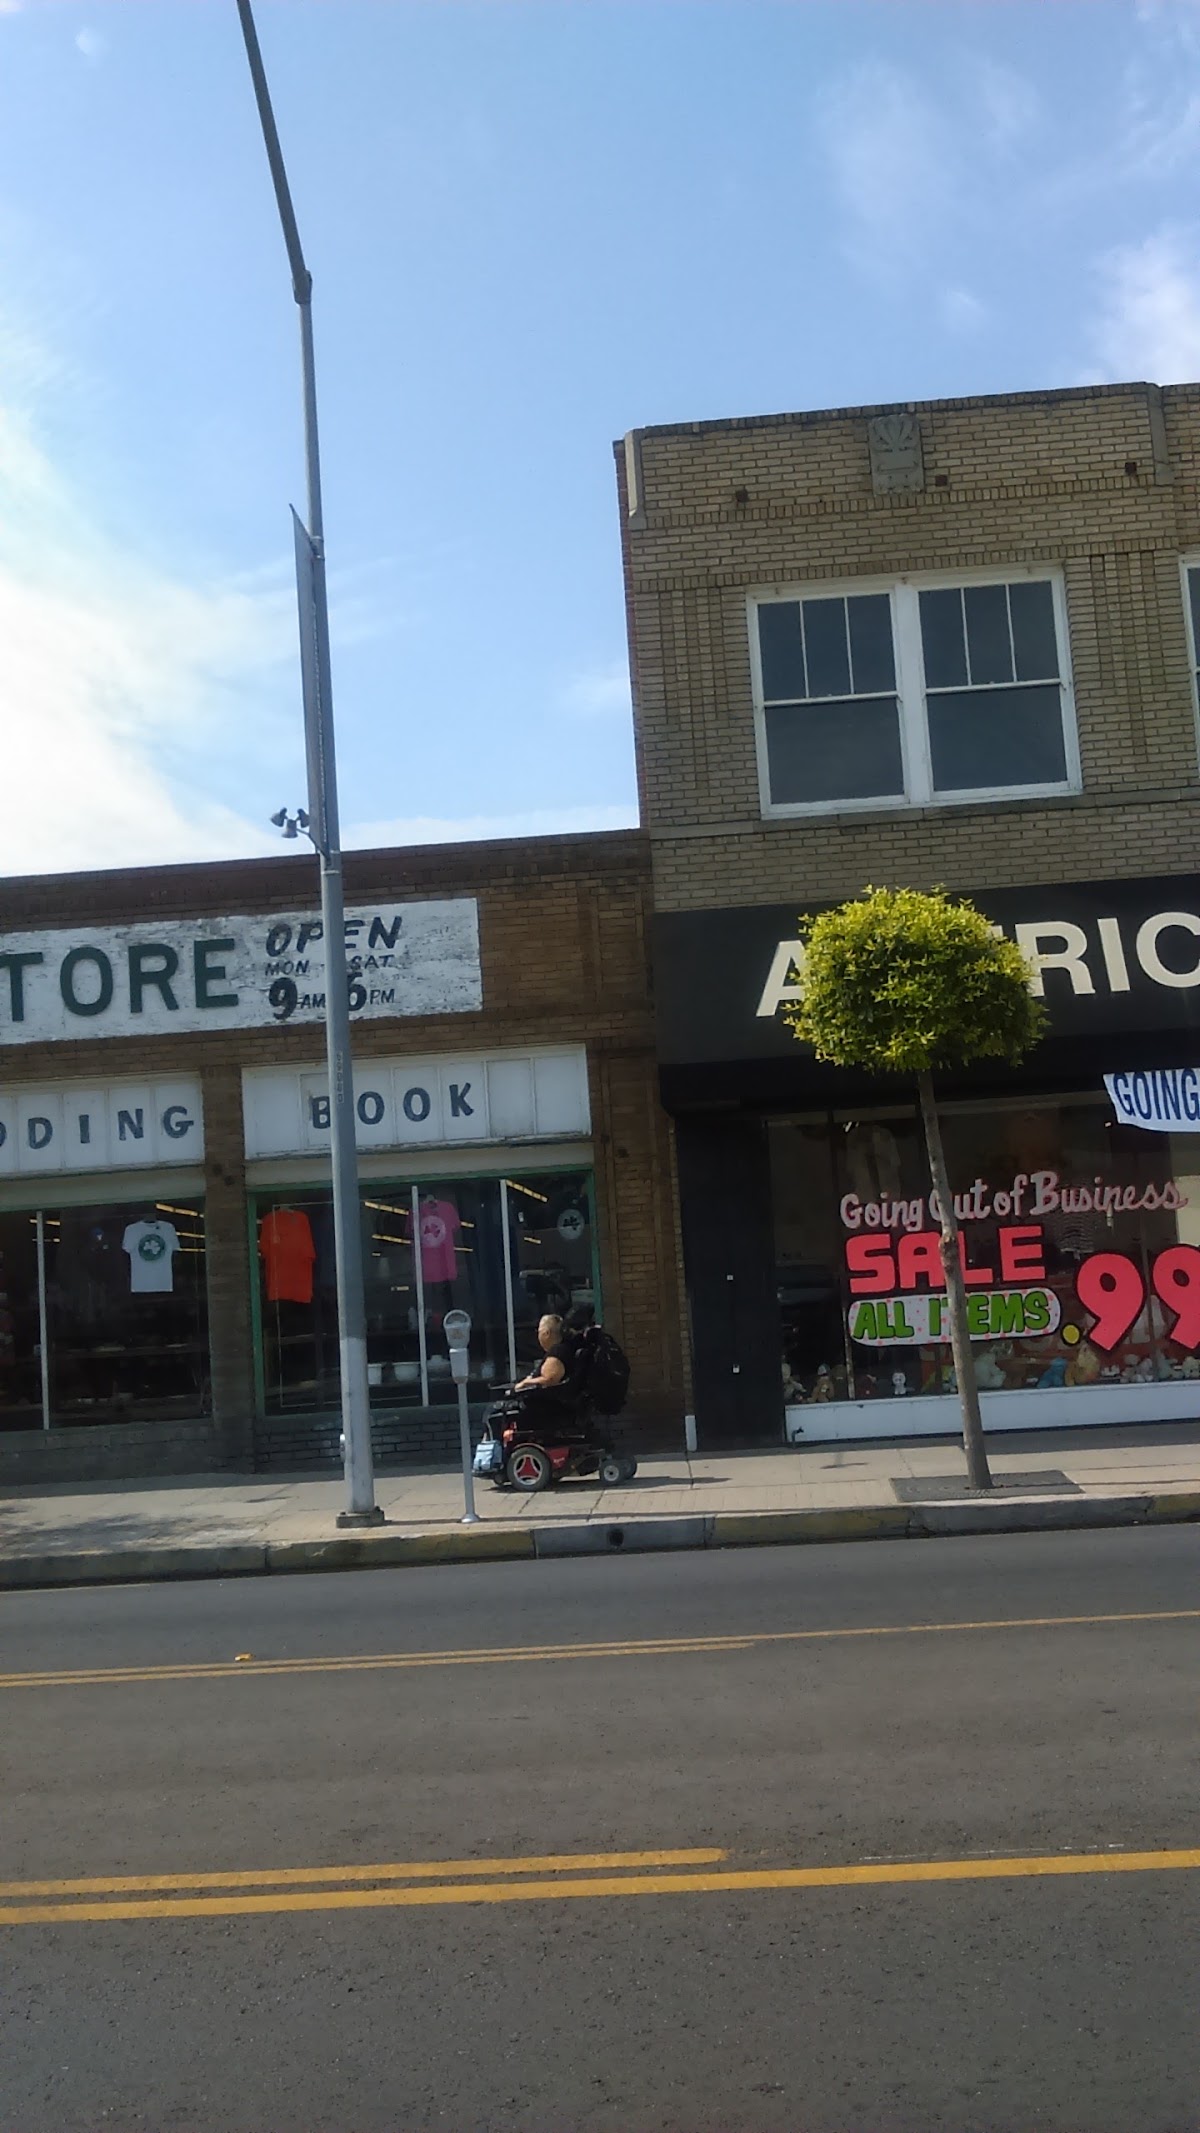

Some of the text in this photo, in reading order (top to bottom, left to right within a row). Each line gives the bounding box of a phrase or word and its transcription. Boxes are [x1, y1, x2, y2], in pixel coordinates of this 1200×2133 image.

[266, 916, 402, 957] OPEN
[0, 938, 239, 1022] TORE
[264, 954, 394, 976] MON SAT
[756, 911, 1200, 1018] ARIC
[311, 1082, 474, 1129] BOOK
[1113, 1068, 1200, 1122] GOING
[0, 1106, 194, 1149] DING
[840, 1192, 923, 1232] Going
[994, 1173, 1028, 1216] of
[1030, 1170, 1188, 1216] Business
[845, 1225, 1046, 1294] SALE
[853, 1290, 1050, 1340] ALL IEMS
